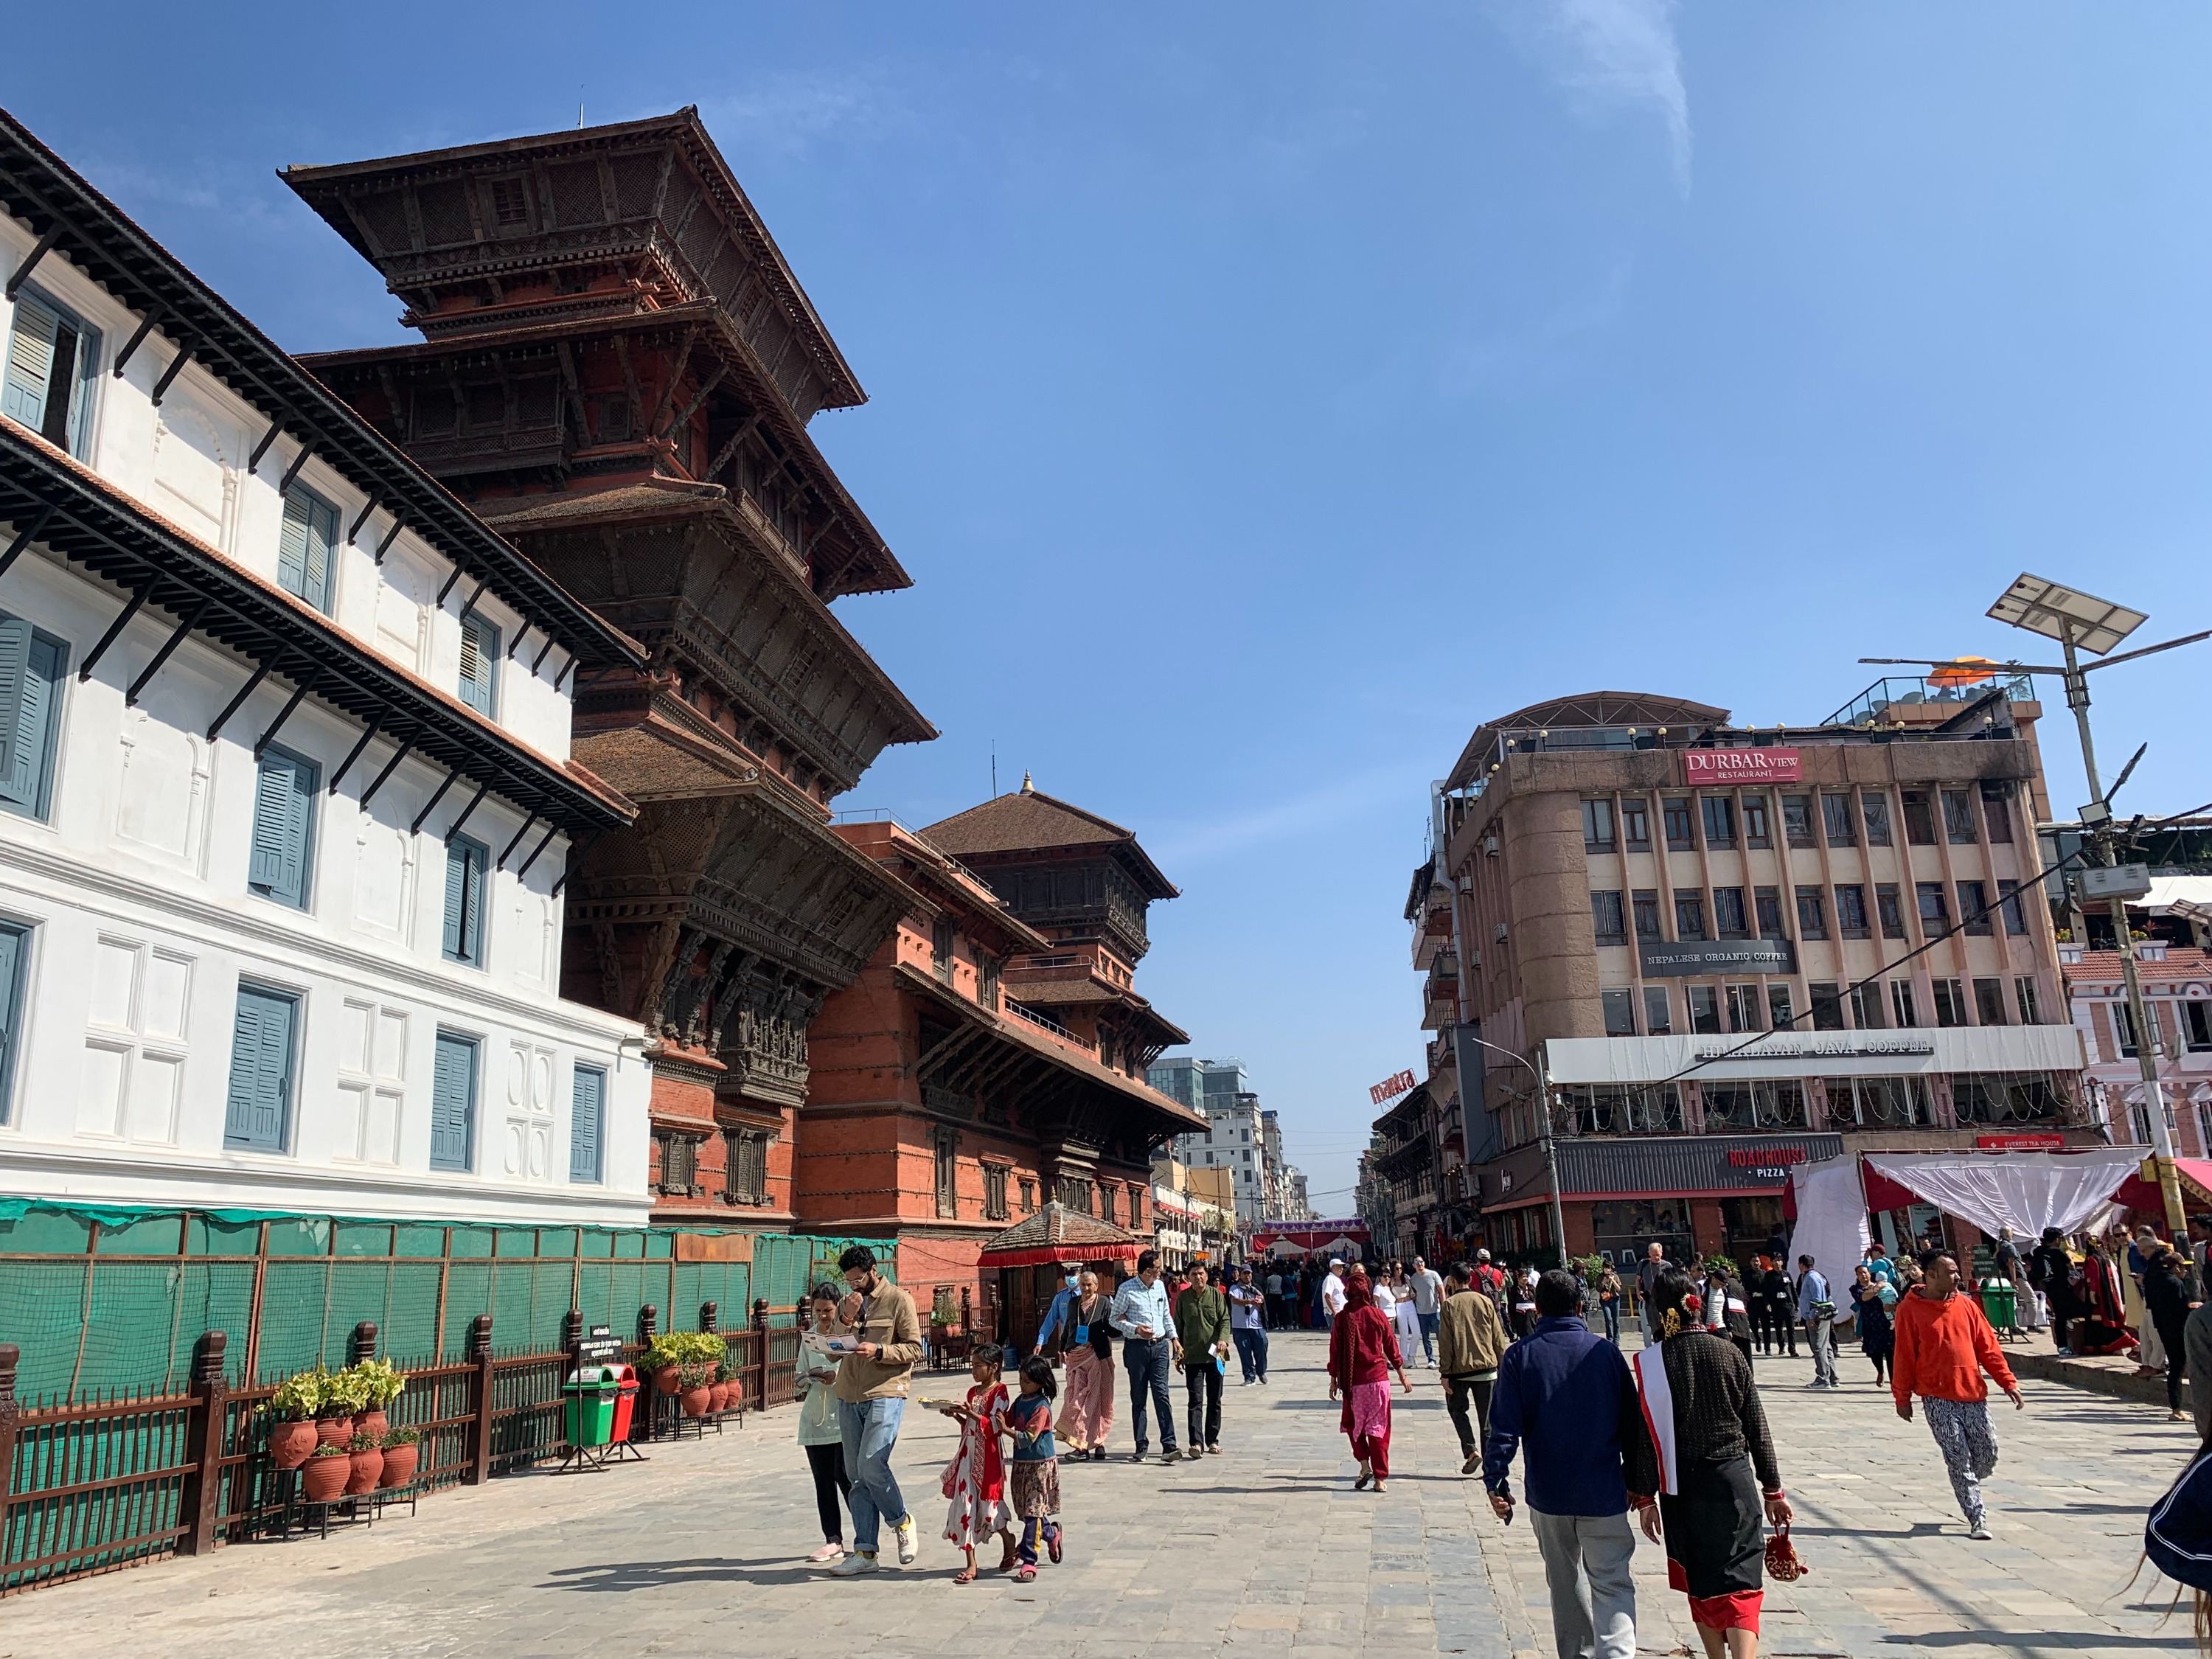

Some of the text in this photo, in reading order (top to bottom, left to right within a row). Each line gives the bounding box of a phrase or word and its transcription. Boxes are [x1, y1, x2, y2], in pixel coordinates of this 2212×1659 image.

[1686, 753, 1798, 771] DURBAR VIEW
[1717, 770, 1773, 779] RESTAURANT
[1647, 952, 1787, 964] NEPALESE ORGANIC COFFEE
[1701, 1039, 1930, 1058] HIMALAYAN JAVA COFFEE
[1729, 1148, 1806, 1167] ROADHOUSE
[1756, 1168, 1785, 1178] PIZZA
